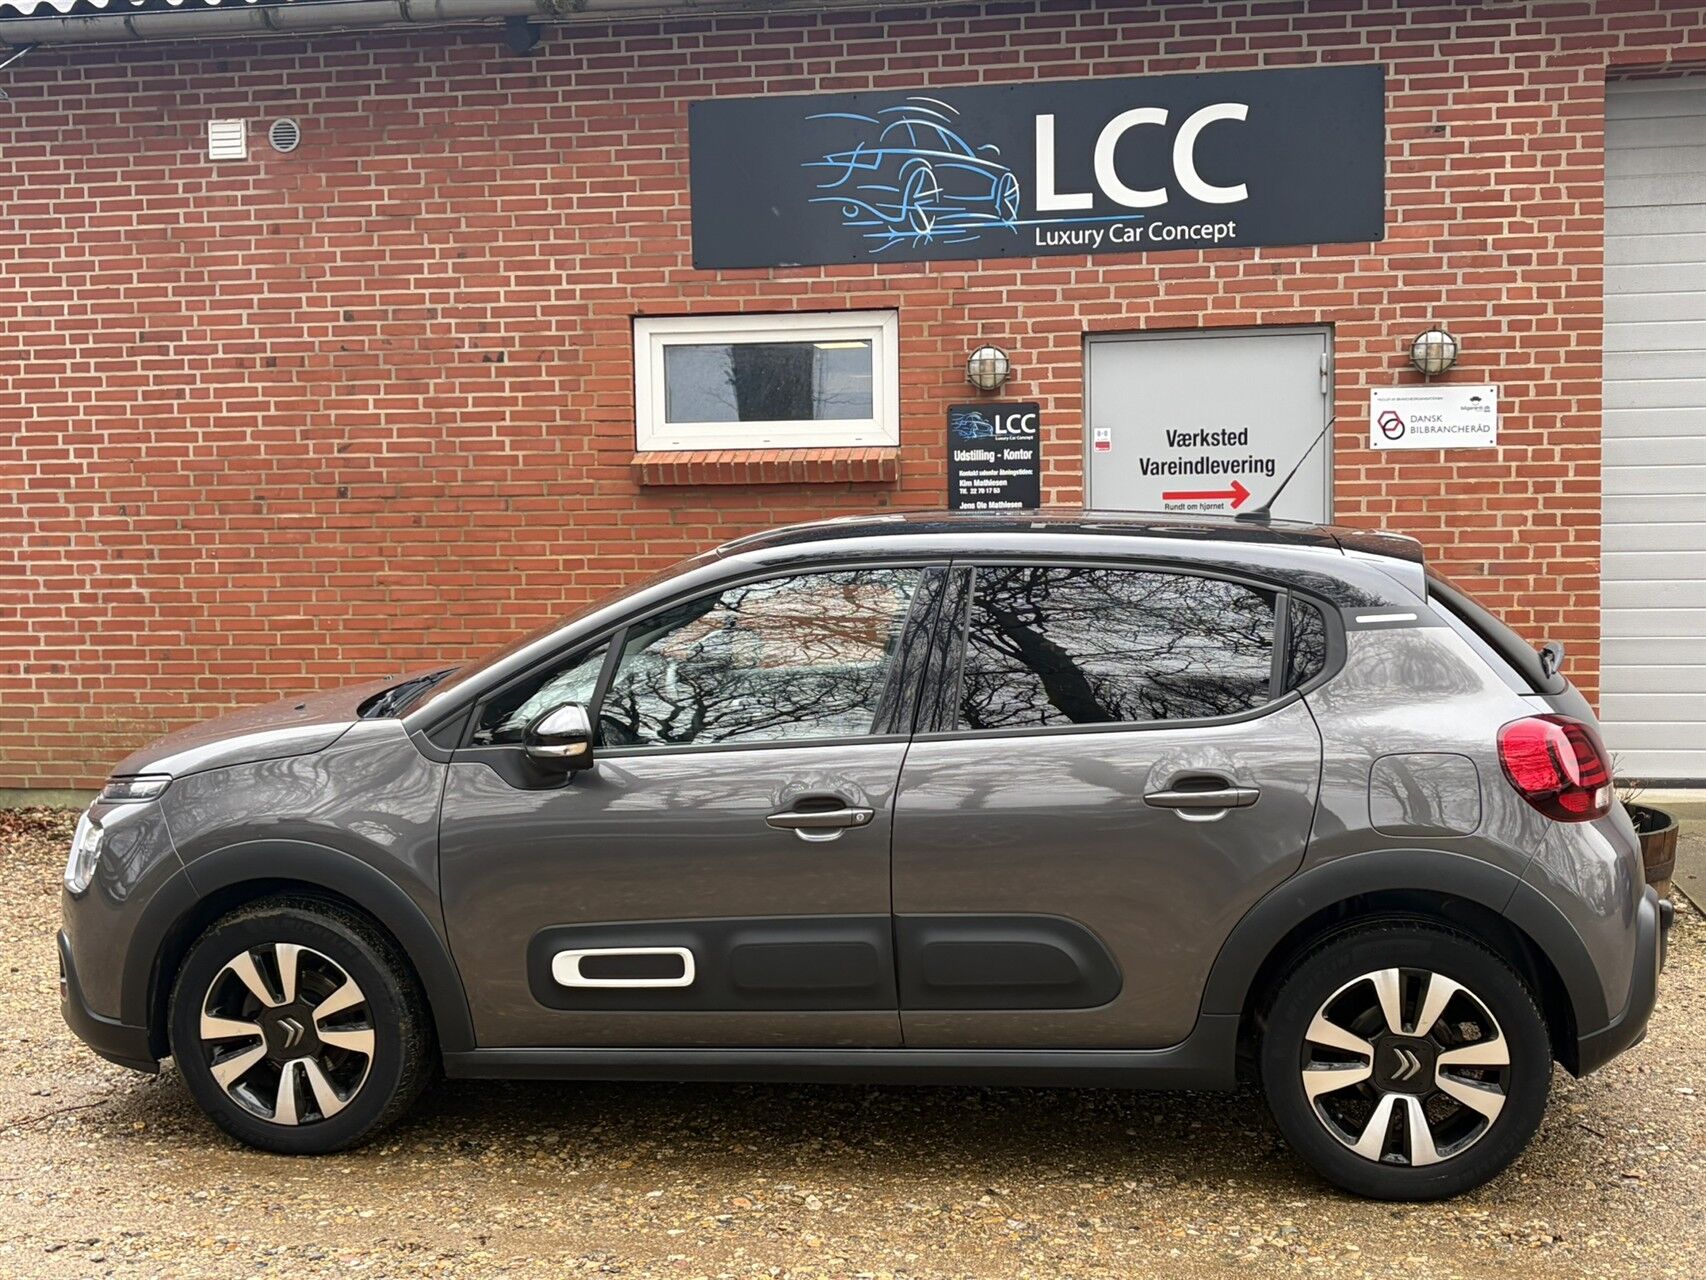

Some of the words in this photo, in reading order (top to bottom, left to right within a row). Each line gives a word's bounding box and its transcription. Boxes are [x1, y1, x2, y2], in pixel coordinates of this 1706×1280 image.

[1035, 102, 1249, 211] LCC
[1035, 225, 1104, 248] Luxury
[1109, 223, 1144, 243] Car
[1148, 221, 1236, 243] Concept
[995, 413, 1036, 434] LCC
[1410, 415, 1443, 423] DANSK
[1166, 428, 1248, 447] Værksted
[1410, 424, 1491, 434] BILBRANCHERÅD
[954, 450, 995, 463] Udstilling
[1003, 448, 1033, 460] Kontor
[1139, 455, 1276, 477] Vareindlevering
[976, 501, 988, 509] Ole
[1164, 503, 1186, 511] Rundt
[1199, 502, 1224, 511] hjørnet
